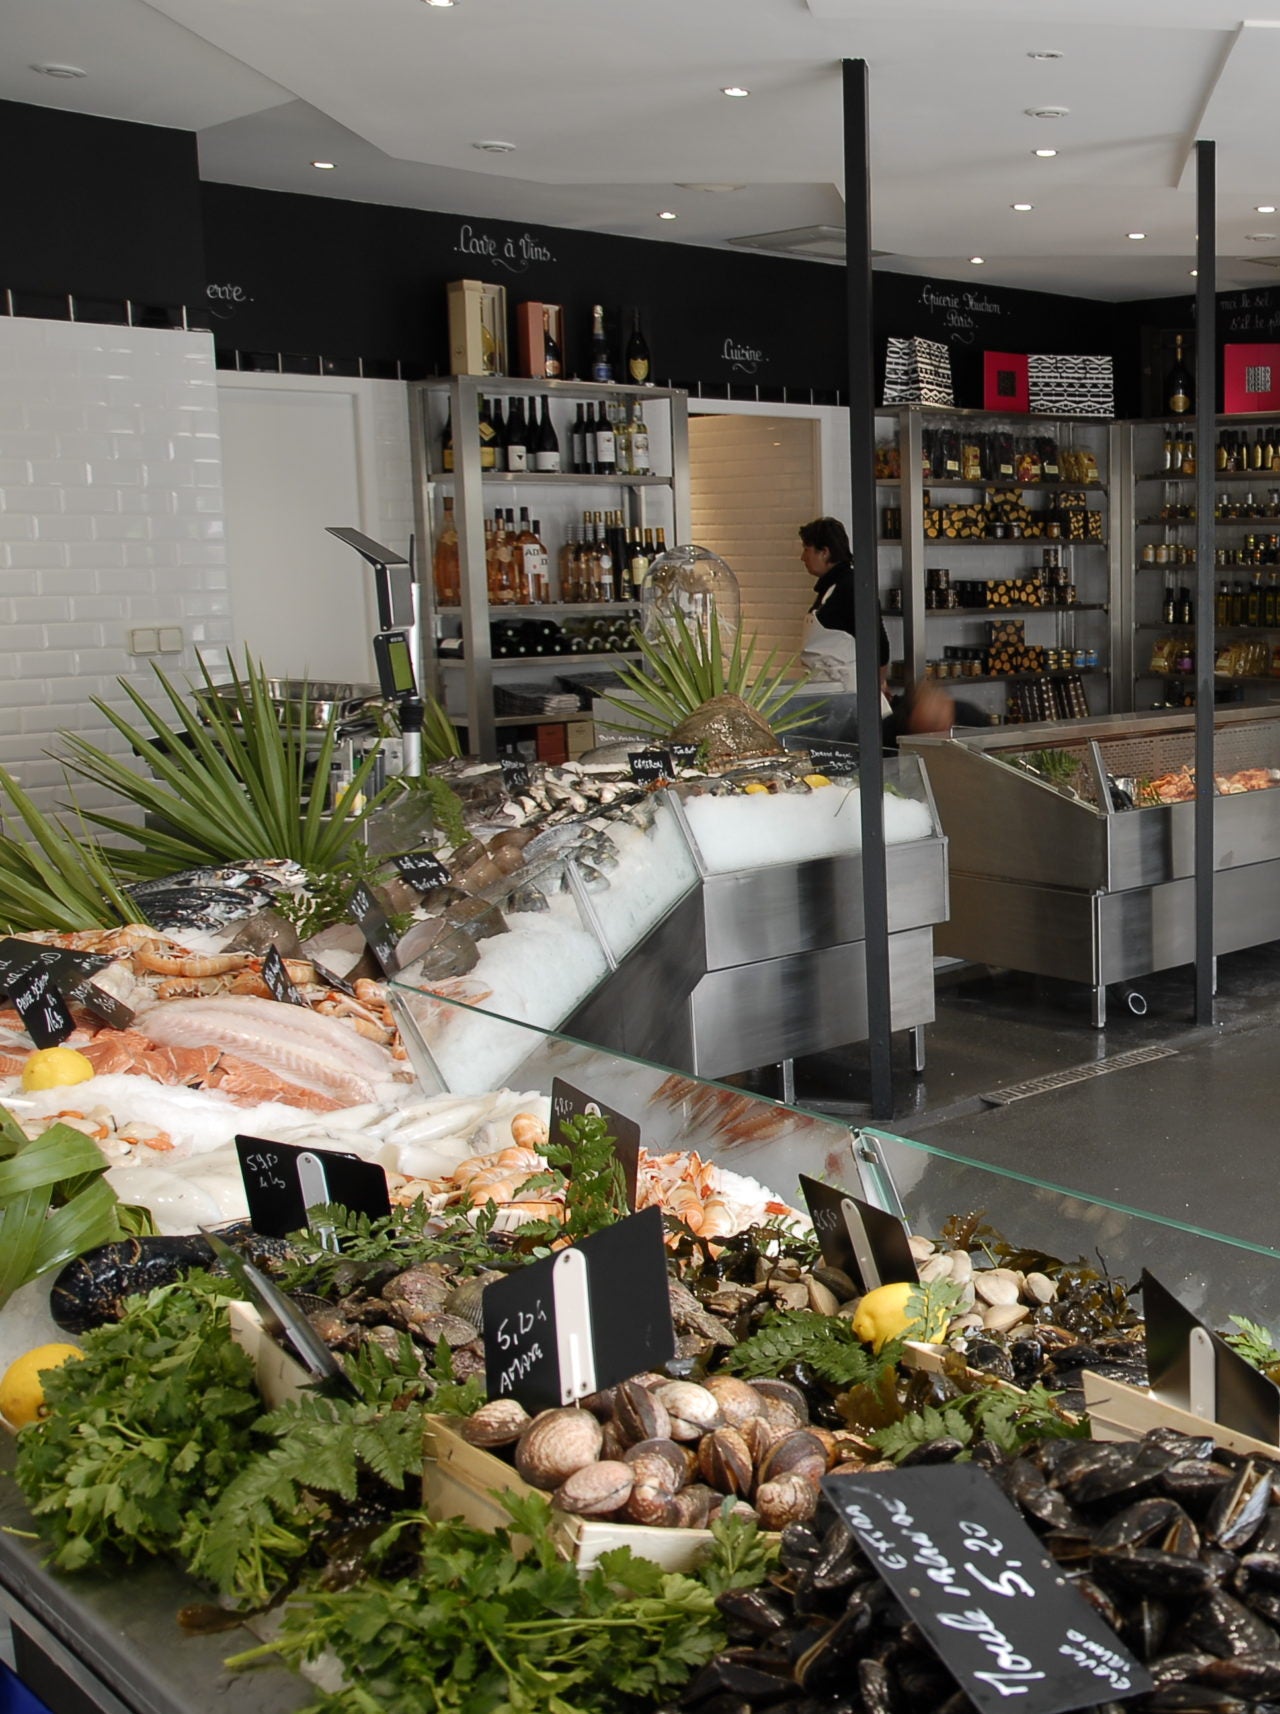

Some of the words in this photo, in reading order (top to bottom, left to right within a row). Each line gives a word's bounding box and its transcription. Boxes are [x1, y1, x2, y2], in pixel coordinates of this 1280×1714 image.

[460, 224, 497, 257] Cave
[504, 237, 516, 258] à
[519, 233, 551, 261] Vins
[724, 337, 763, 361] Cuisine
[845, 1503, 908, 1571] EXTRA
[958, 1519, 1036, 1598] 5,20
